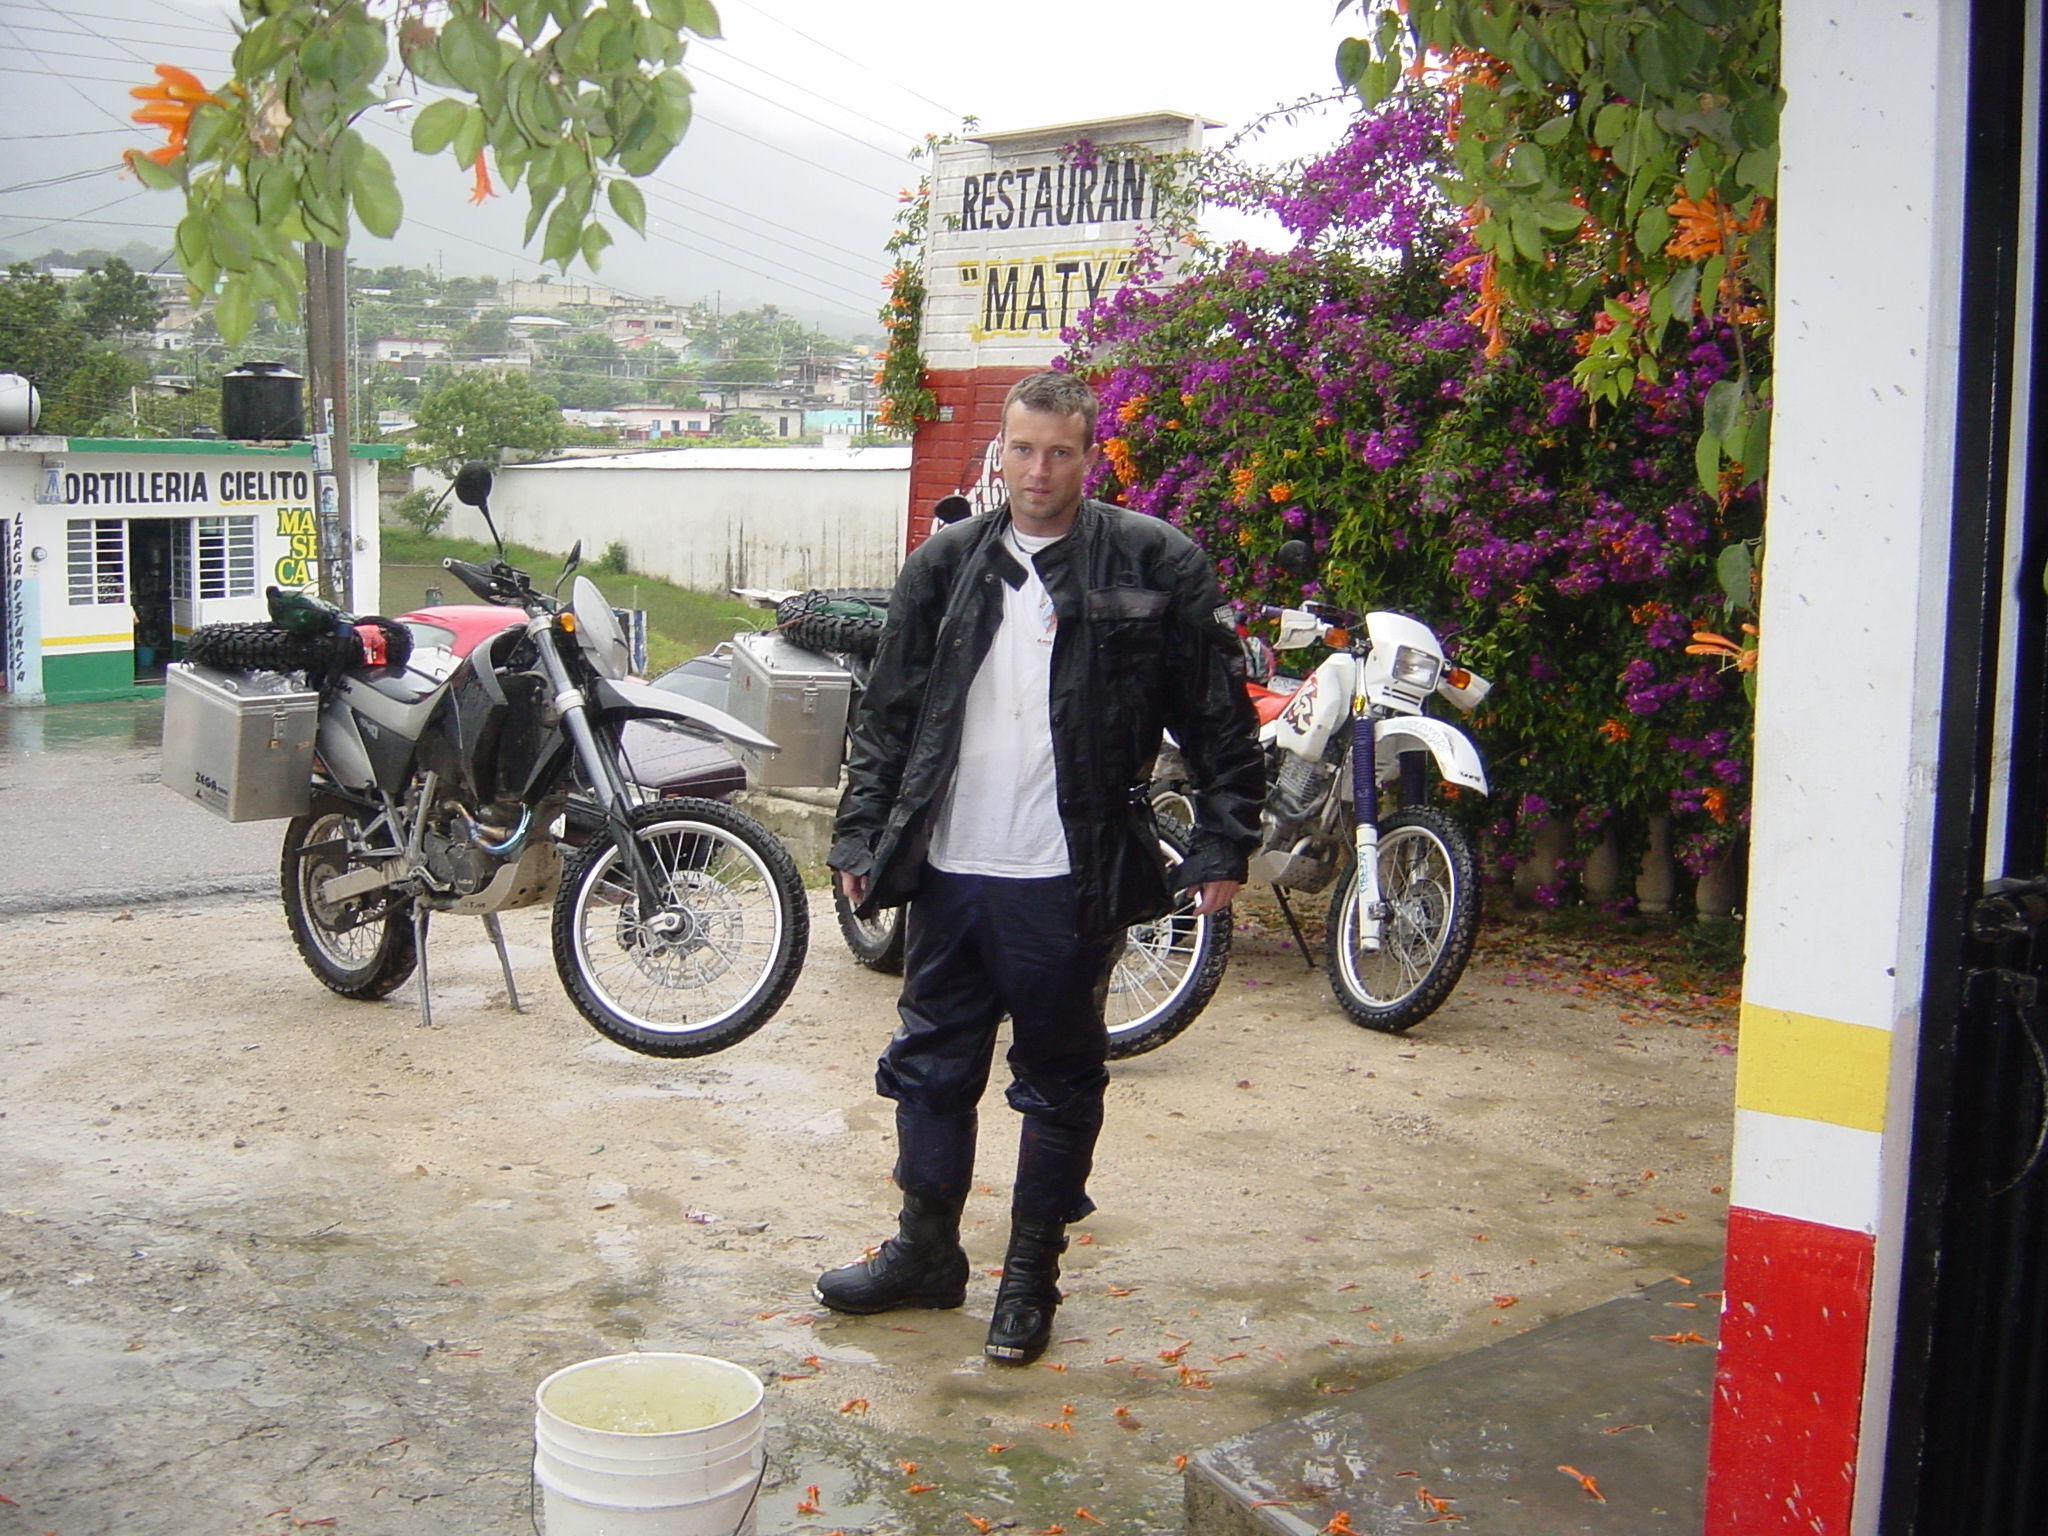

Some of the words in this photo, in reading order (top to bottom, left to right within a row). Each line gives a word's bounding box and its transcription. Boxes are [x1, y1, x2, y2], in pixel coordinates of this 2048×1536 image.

[65, 472, 208, 504] ORTILLERIA
[220, 471, 308, 501] CIELITO
[277, 507, 318, 536] MA
[13, 512, 23, 576] LARGA
[275, 556, 313, 586] CA
[13, 579, 25, 682] DISTANCIA
